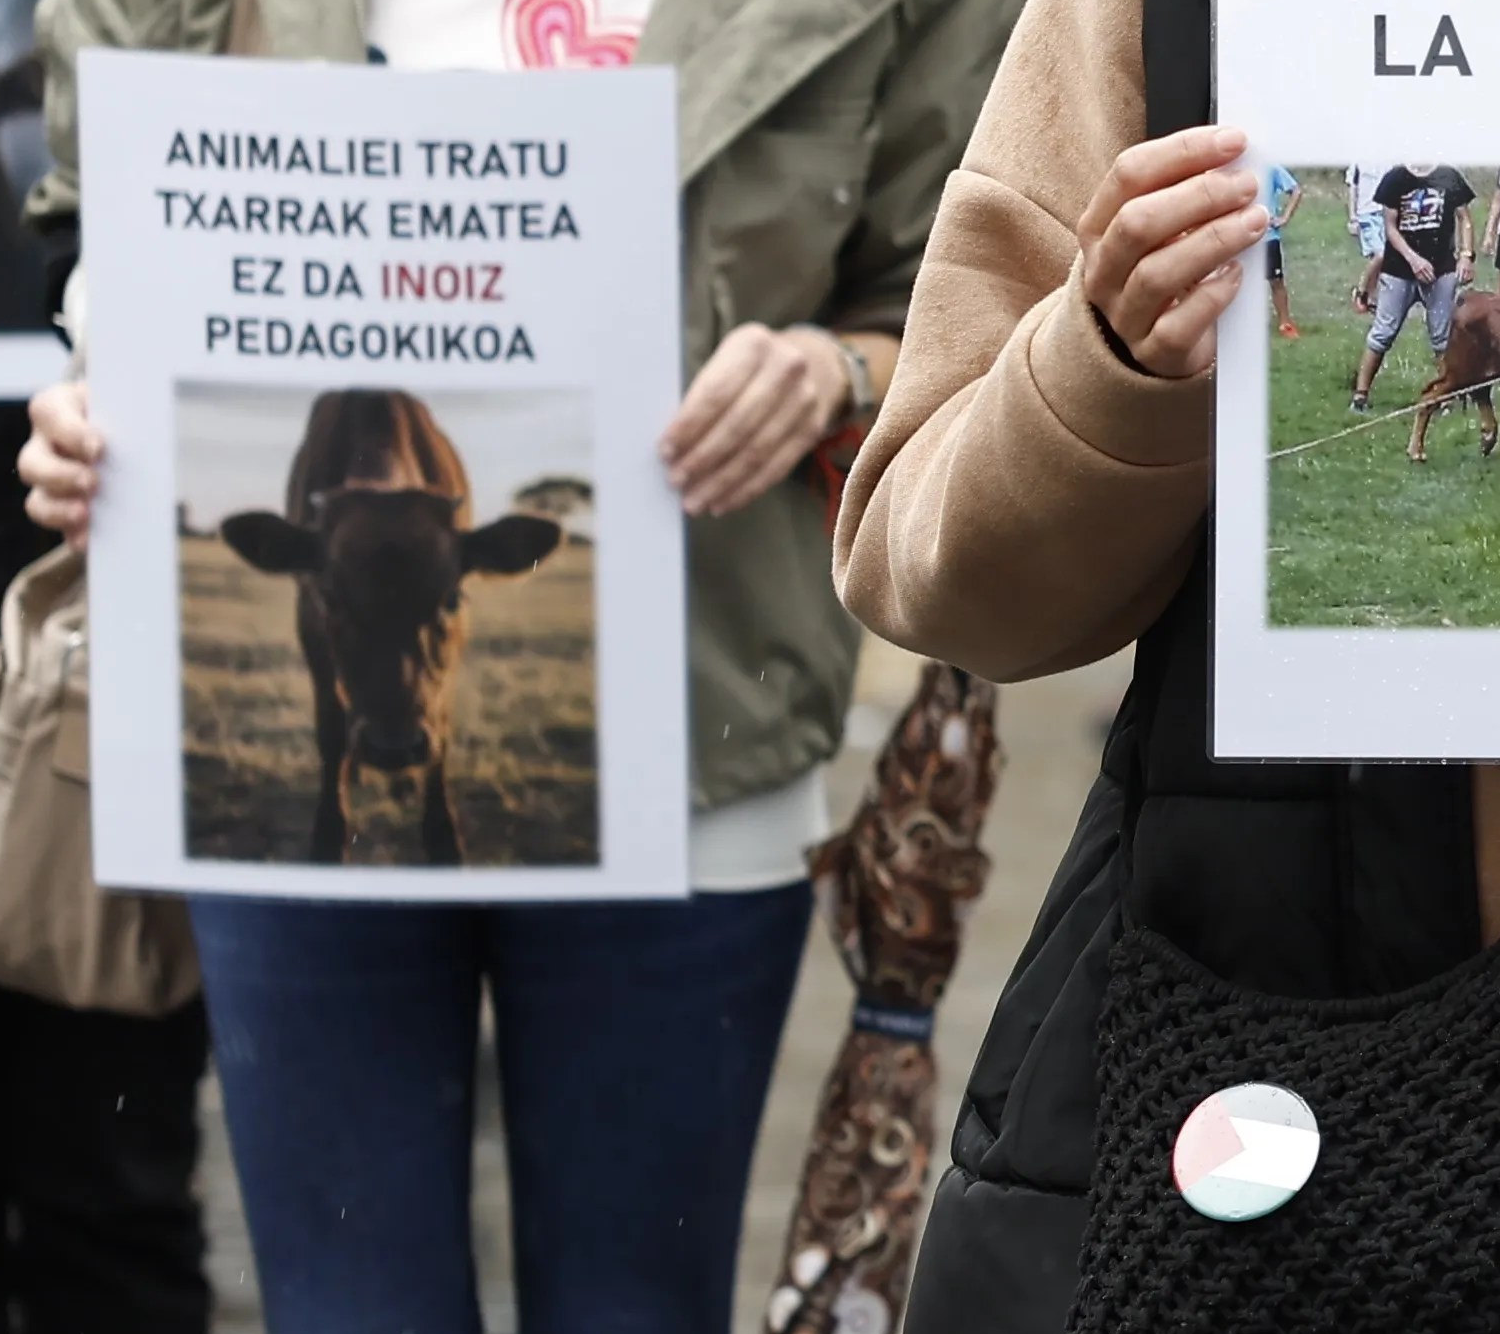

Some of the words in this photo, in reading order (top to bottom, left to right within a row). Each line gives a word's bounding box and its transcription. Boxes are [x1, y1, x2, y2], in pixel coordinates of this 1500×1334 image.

[1374, 15, 1472, 76] LA
[167, 131, 401, 176] ANIMALIEI
[418, 142, 567, 177] TRATU
[157, 191, 368, 237] TXARRAK
[389, 203, 579, 239] EMATEA
[233, 257, 284, 295] EZ
[304, 261, 363, 298] DA
[382, 264, 503, 301] INOIZ
[207, 316, 535, 361] PEDAGOKIKOA
